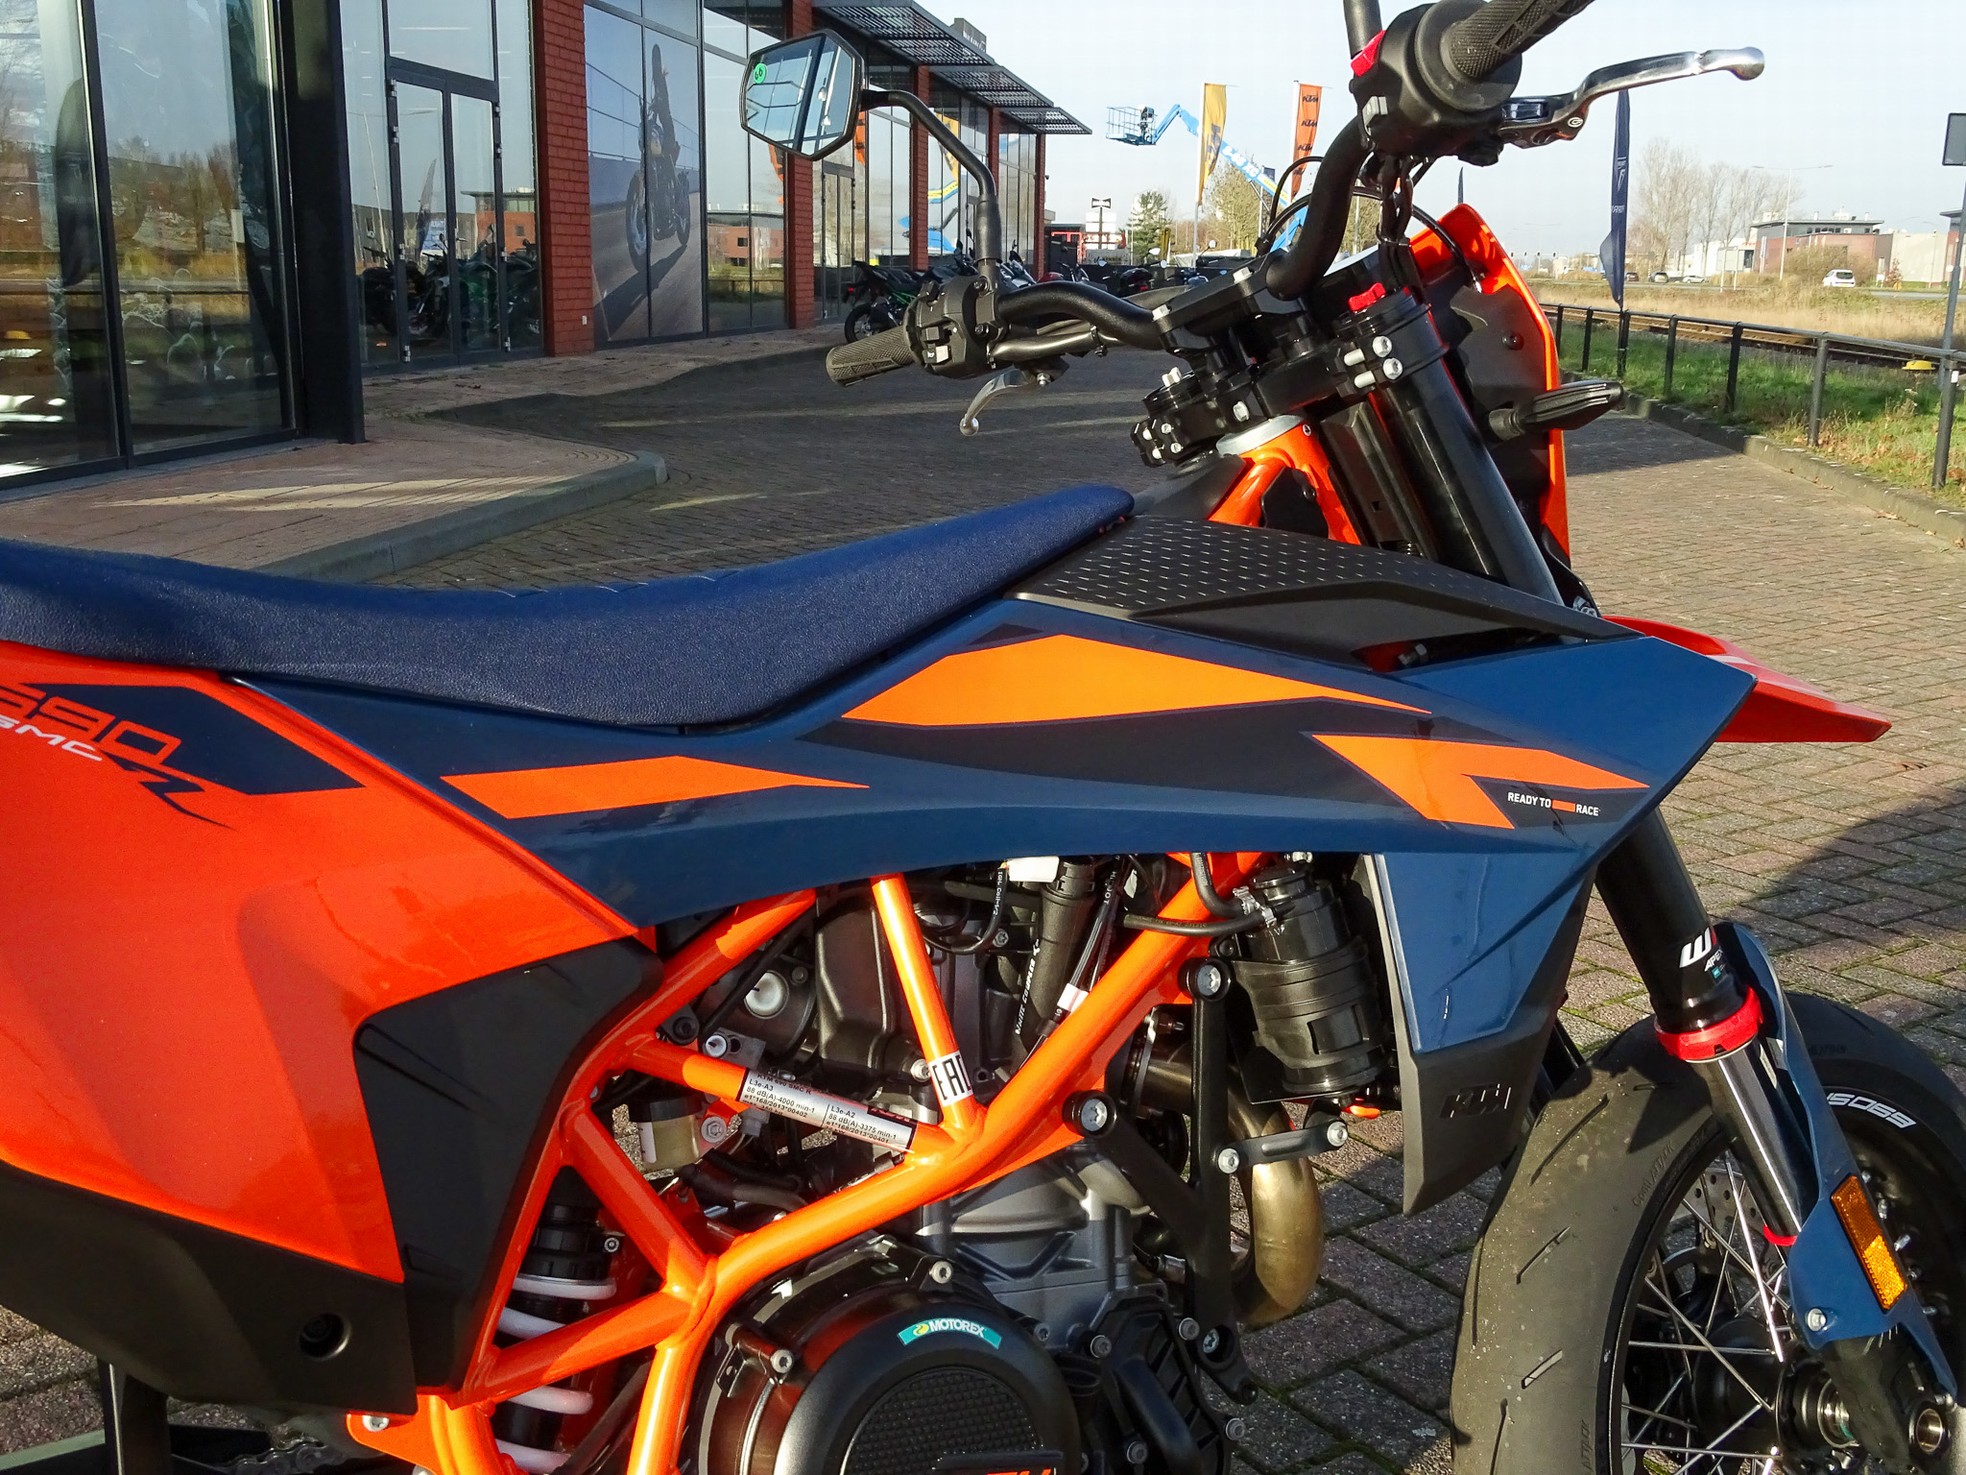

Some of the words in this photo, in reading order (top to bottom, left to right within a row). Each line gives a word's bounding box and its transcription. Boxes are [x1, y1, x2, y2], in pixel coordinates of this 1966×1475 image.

[1507, 791, 1538, 806] READY
[1539, 797, 1552, 808] TO
[1576, 803, 1600, 817] RACE
[749, 1078, 774, 1092] L3e-A3
[746, 1086, 756, 1094] 88
[756, 1088, 795, 1107] dB(A)-4000
[795, 1101, 816, 1113] min-1
[831, 1105, 856, 1119] L3e-A2
[828, 1113, 837, 1121] 88
[838, 1116, 877, 1134] dB(A)-3375
[877, 1129, 897, 1141] min-1
[928, 1319, 986, 1338] MOTOREX
